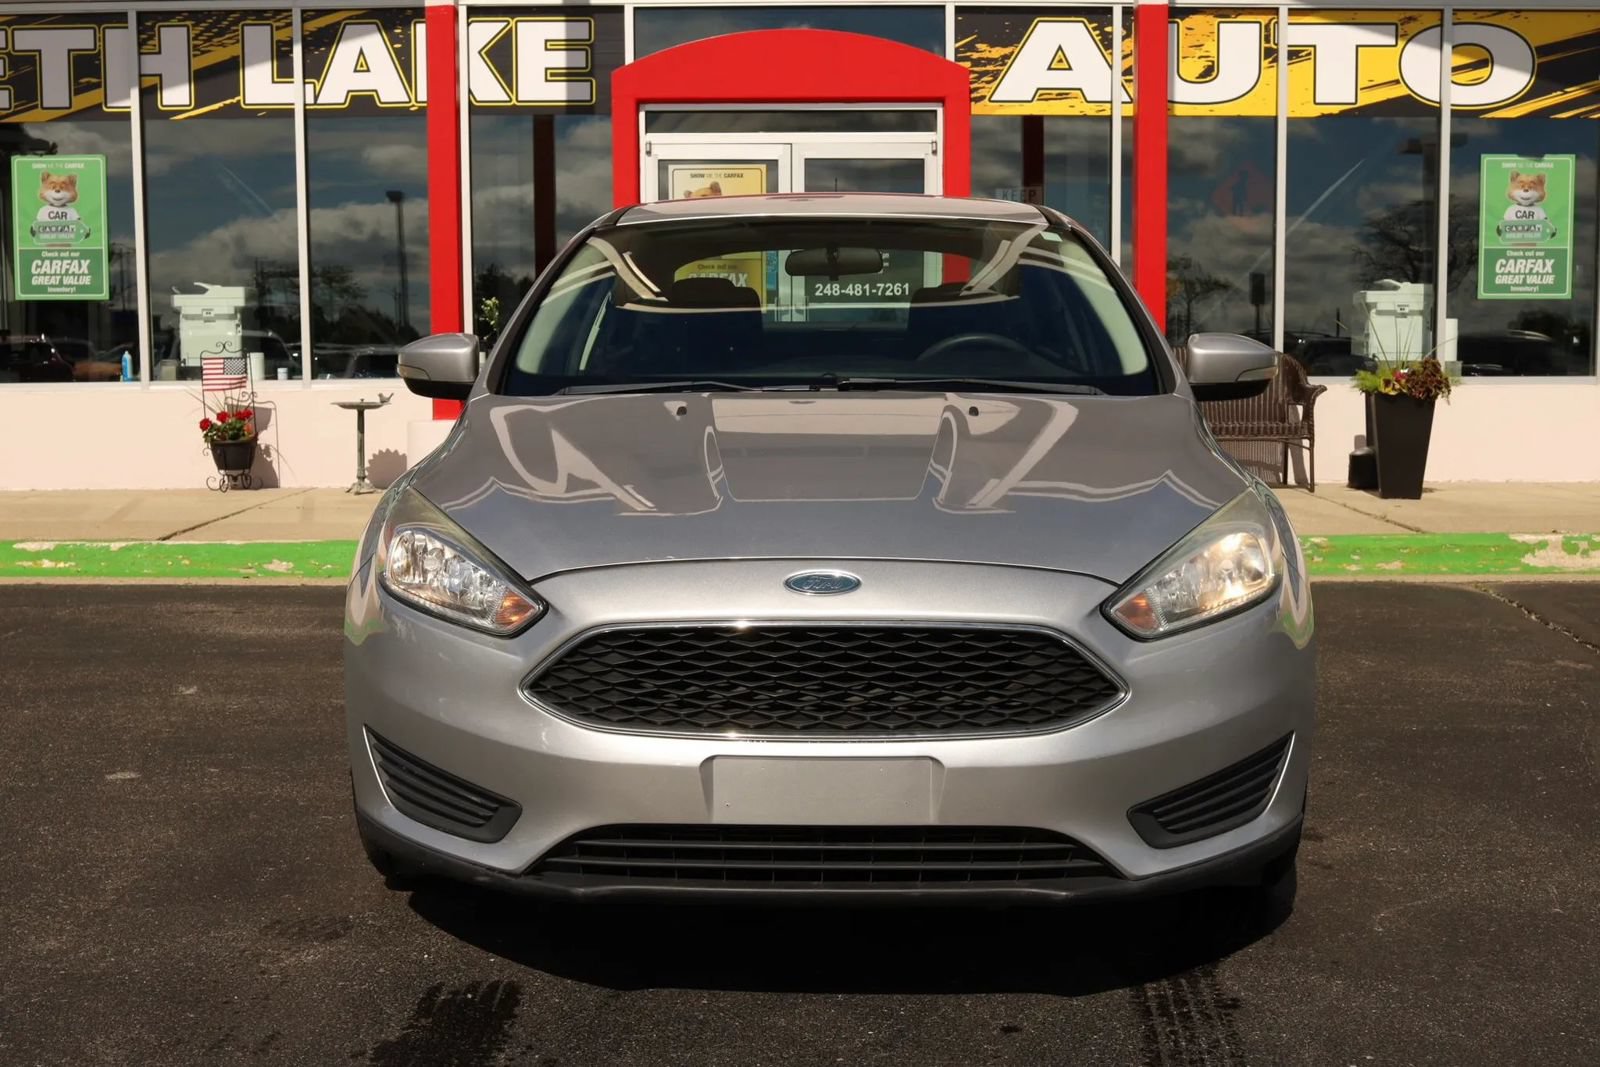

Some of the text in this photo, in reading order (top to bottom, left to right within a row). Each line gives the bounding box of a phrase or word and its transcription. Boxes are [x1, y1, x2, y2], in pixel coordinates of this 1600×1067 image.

[0, 18, 1537, 111] TH LAKE AUTO
[48, 210, 68, 220] CAR
[1515, 210, 1535, 219] CAR
[31, 259, 91, 274] CARFAX
[1495, 258, 1555, 273] CARFAX
[31, 275, 92, 285] GREAT VALUE
[1495, 274, 1556, 284] GREAT VALUE
[814, 283, 909, 296] 248-481-7261
